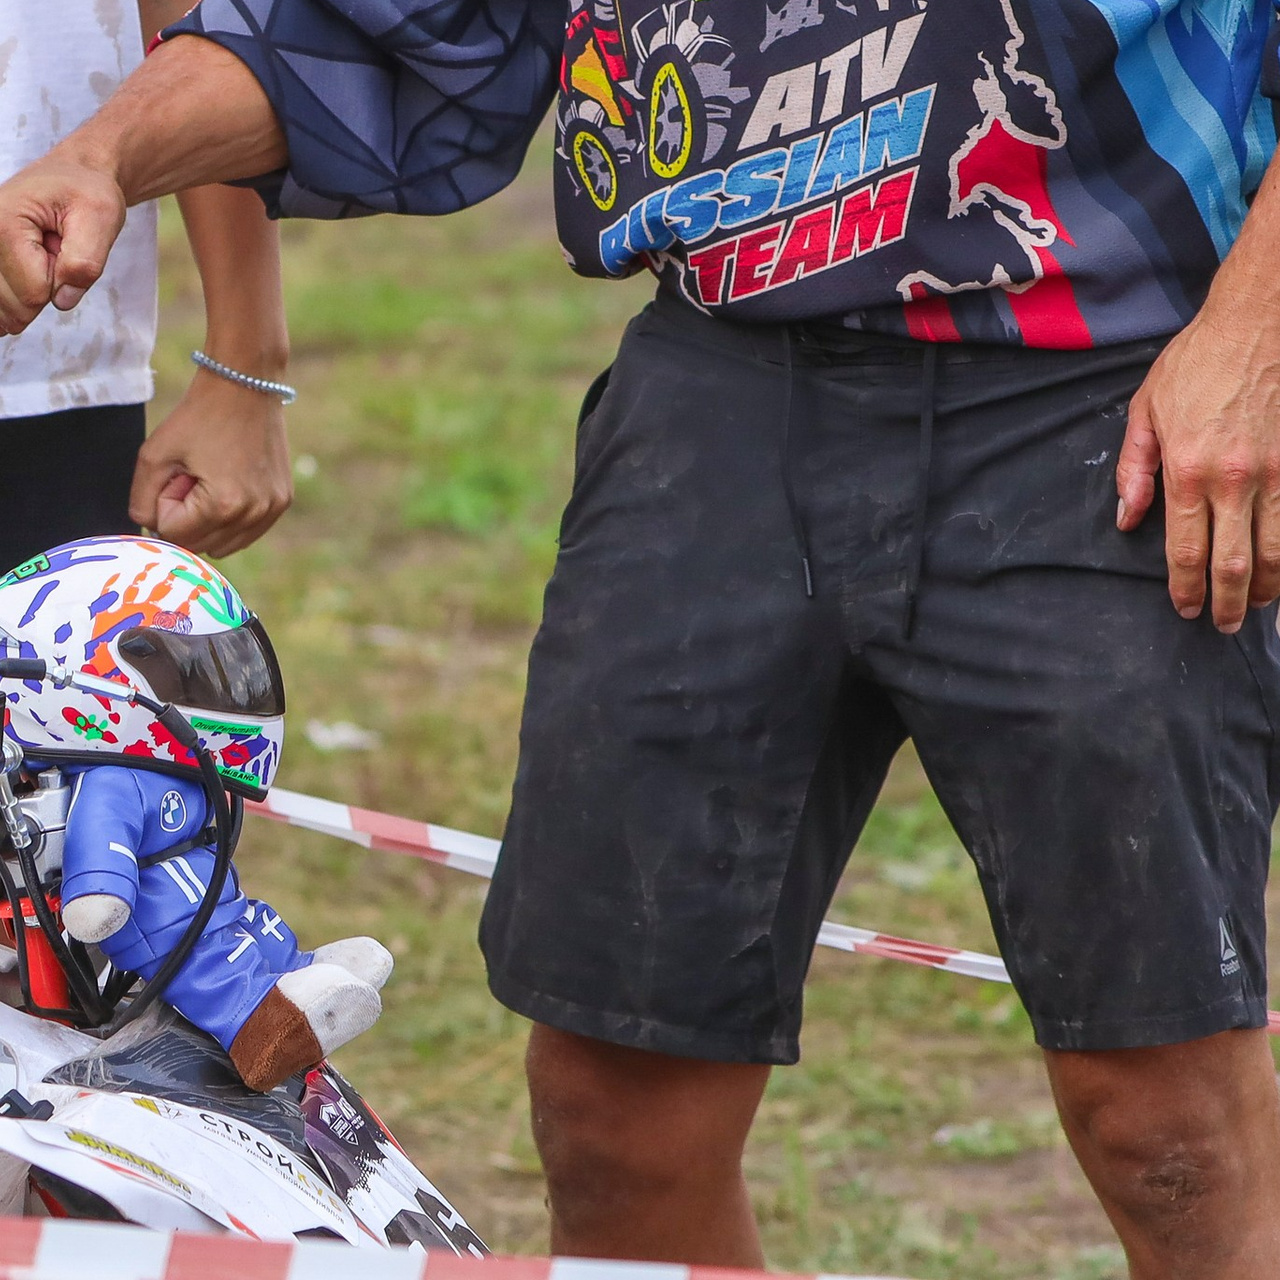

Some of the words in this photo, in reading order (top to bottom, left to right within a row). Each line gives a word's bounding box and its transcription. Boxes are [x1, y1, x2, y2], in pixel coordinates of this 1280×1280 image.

[736, 11, 927, 152] ATV
[599, 82, 938, 274] RUSSIAN
[687, 165, 920, 305] TEAM
